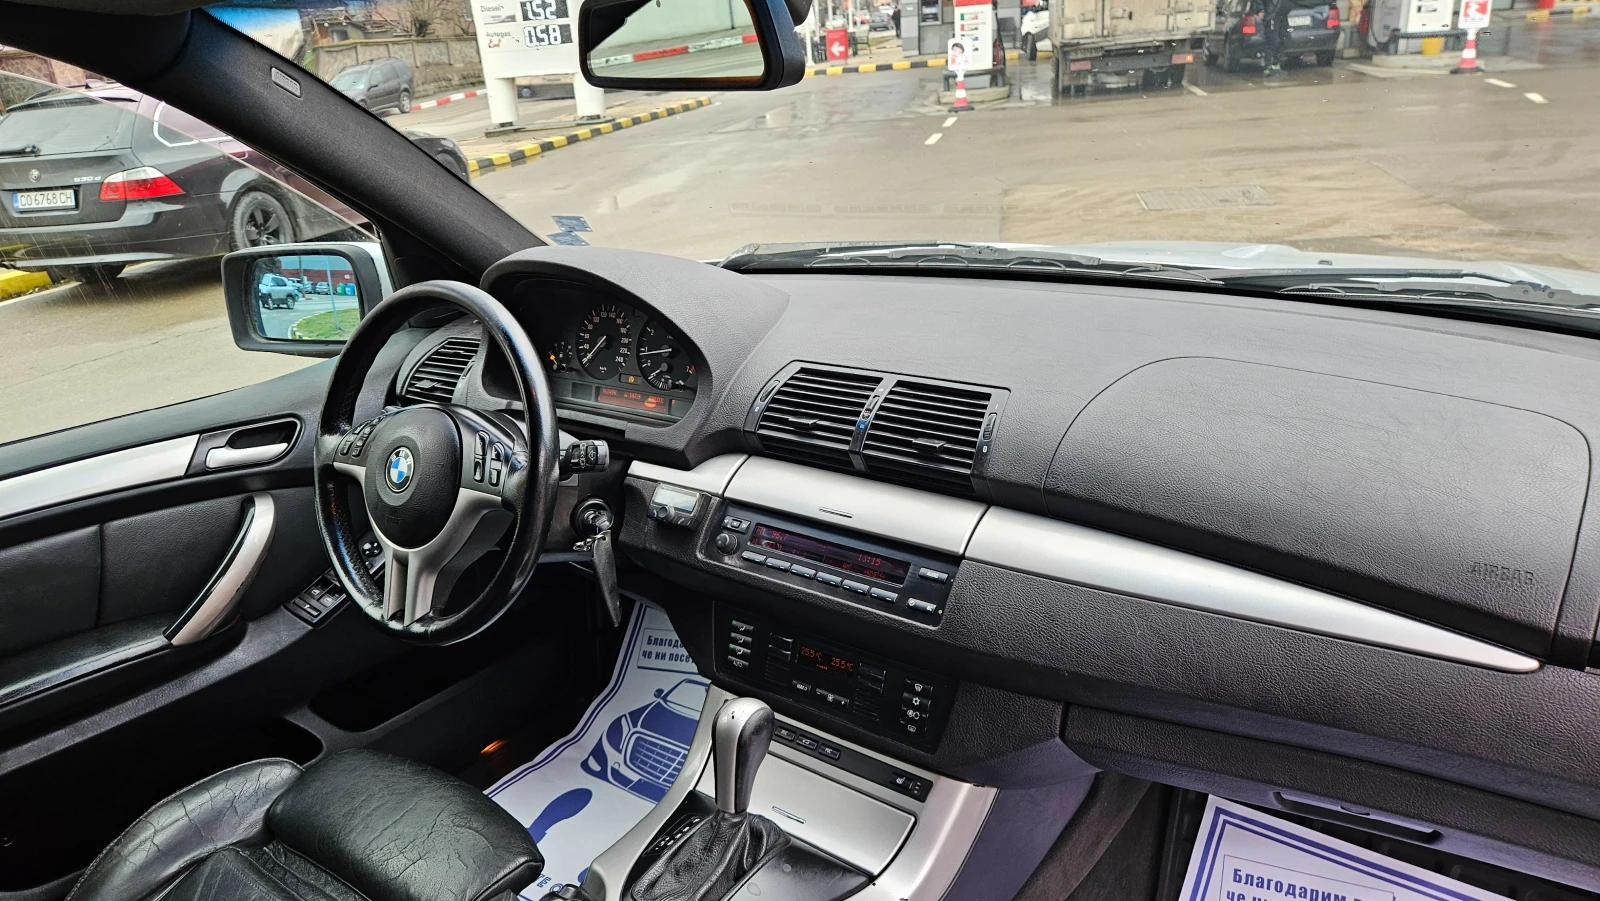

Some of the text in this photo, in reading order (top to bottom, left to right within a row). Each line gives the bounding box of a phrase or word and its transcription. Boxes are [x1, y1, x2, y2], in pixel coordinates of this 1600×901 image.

[480, 4, 502, 12] Diesel
[34, 193, 58, 205] 6768
[1470, 561, 1534, 586] AIRBAG
[642, 650, 694, 664] че ни посе
[1232, 868, 1347, 901] Благодарим
